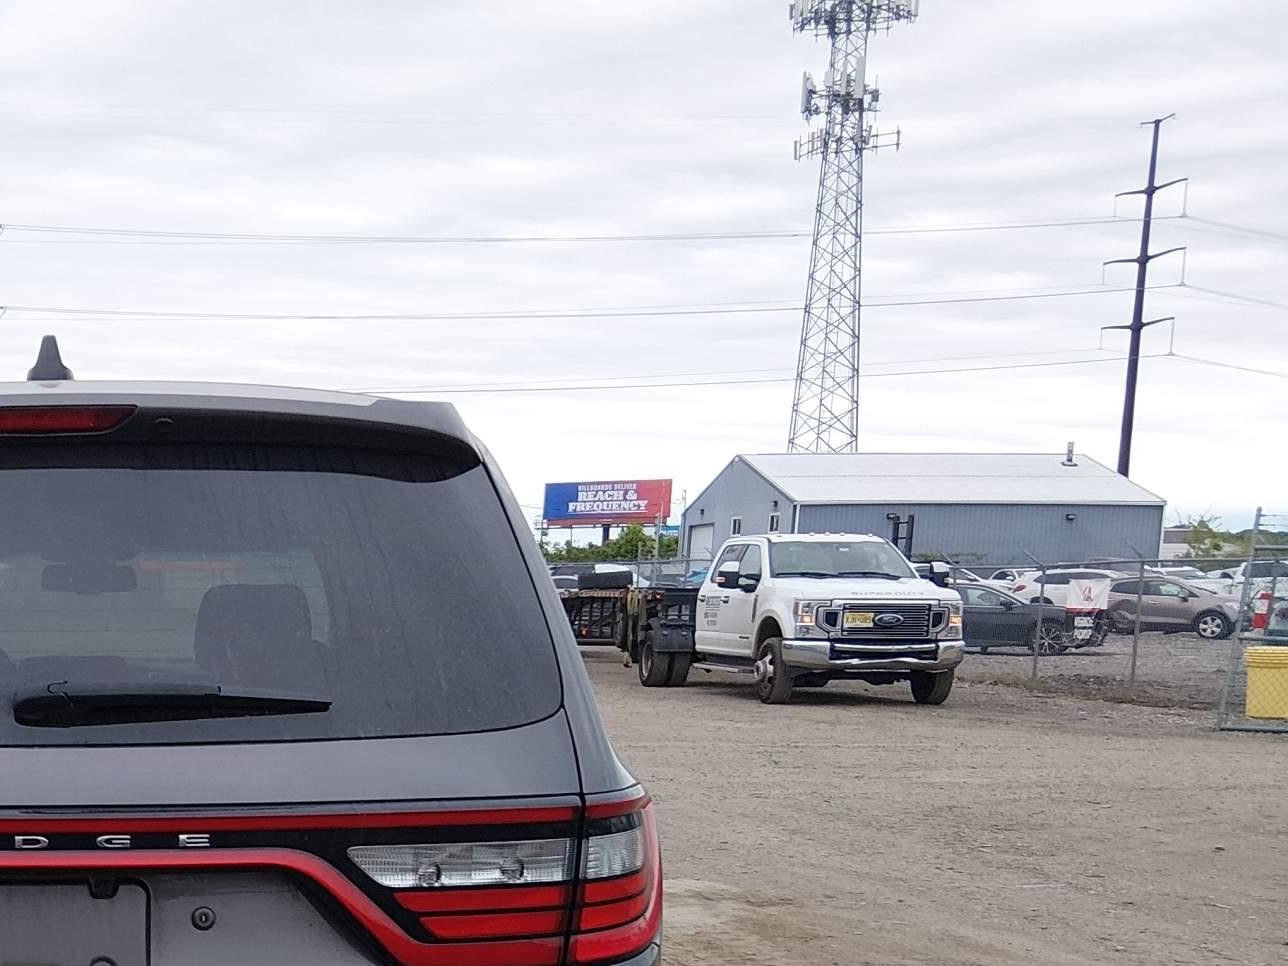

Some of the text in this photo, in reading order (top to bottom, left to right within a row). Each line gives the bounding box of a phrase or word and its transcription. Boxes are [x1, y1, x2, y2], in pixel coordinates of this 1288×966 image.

[578, 490, 637, 501] REACH &
[568, 500, 648, 512] FREQUENCY
